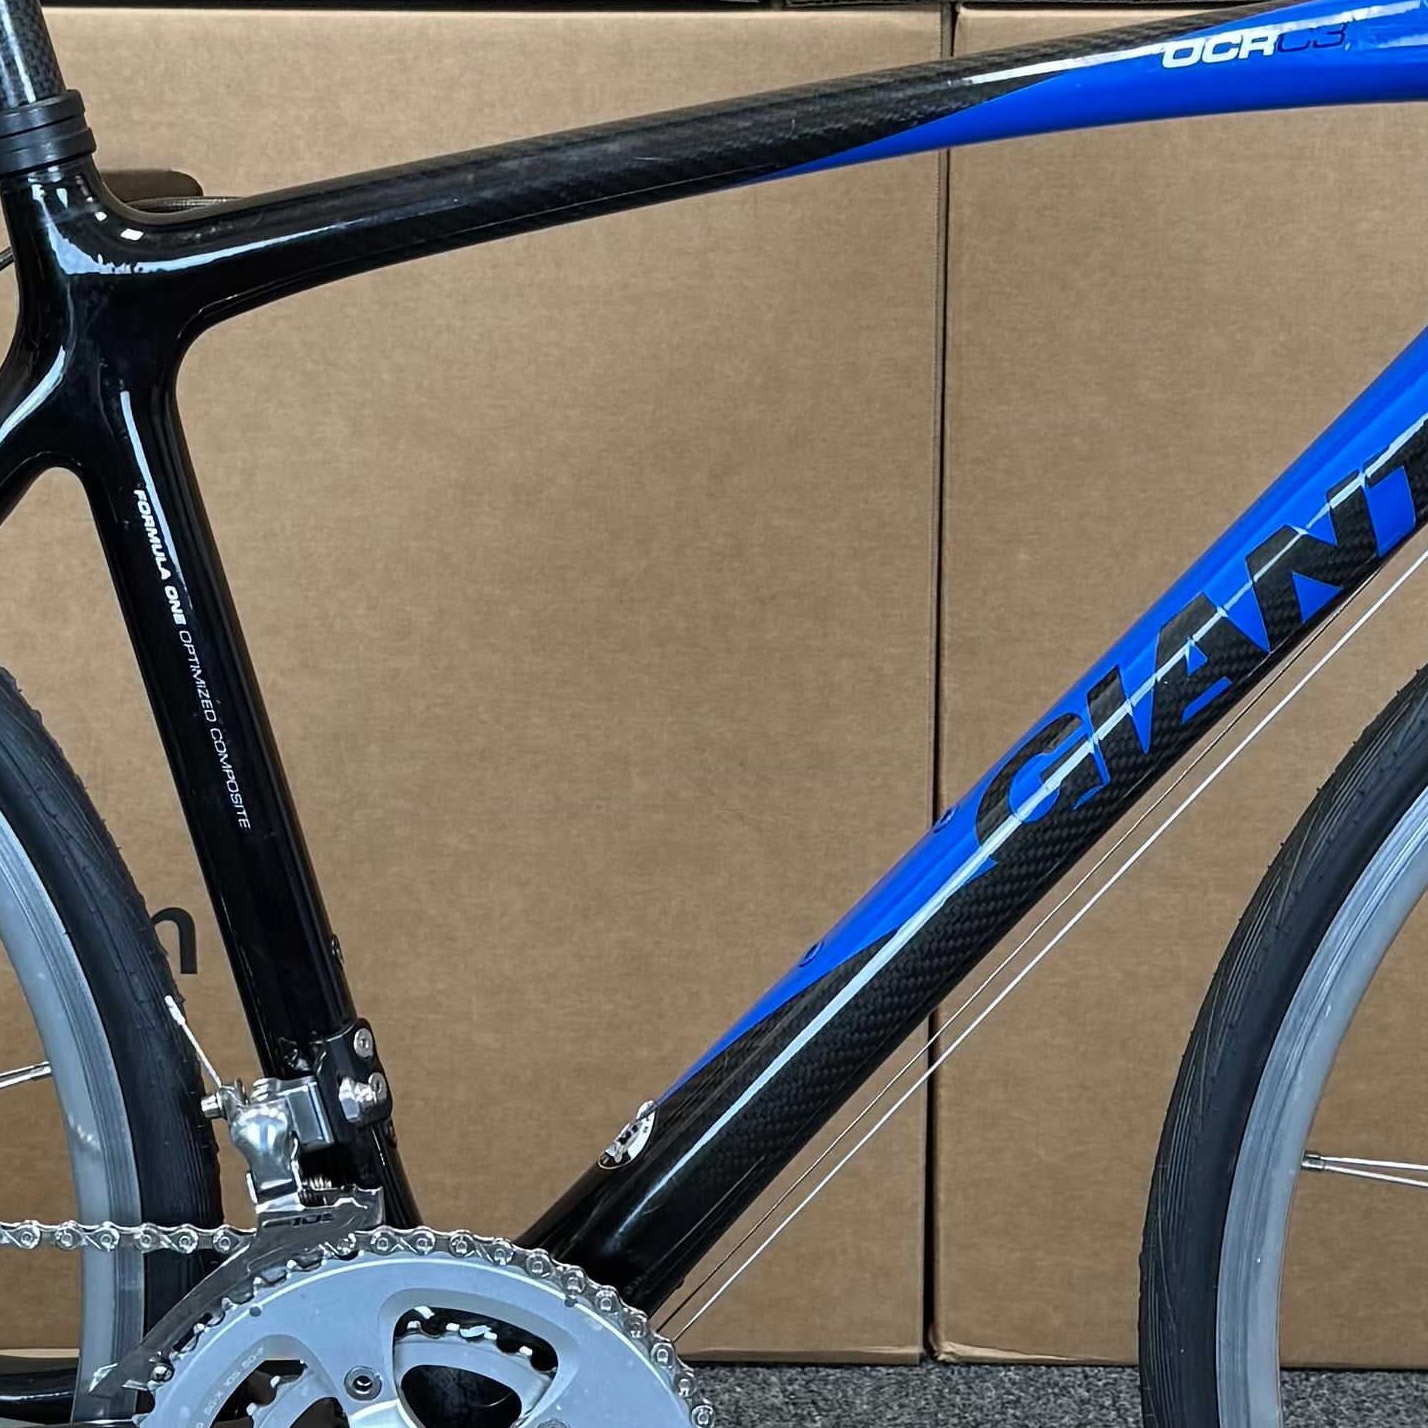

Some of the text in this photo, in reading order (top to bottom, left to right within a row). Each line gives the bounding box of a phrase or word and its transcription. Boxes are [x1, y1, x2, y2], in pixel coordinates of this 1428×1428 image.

[133, 488, 252, 832] FORMULA ONE OPTIMIZED COMPOSITE
